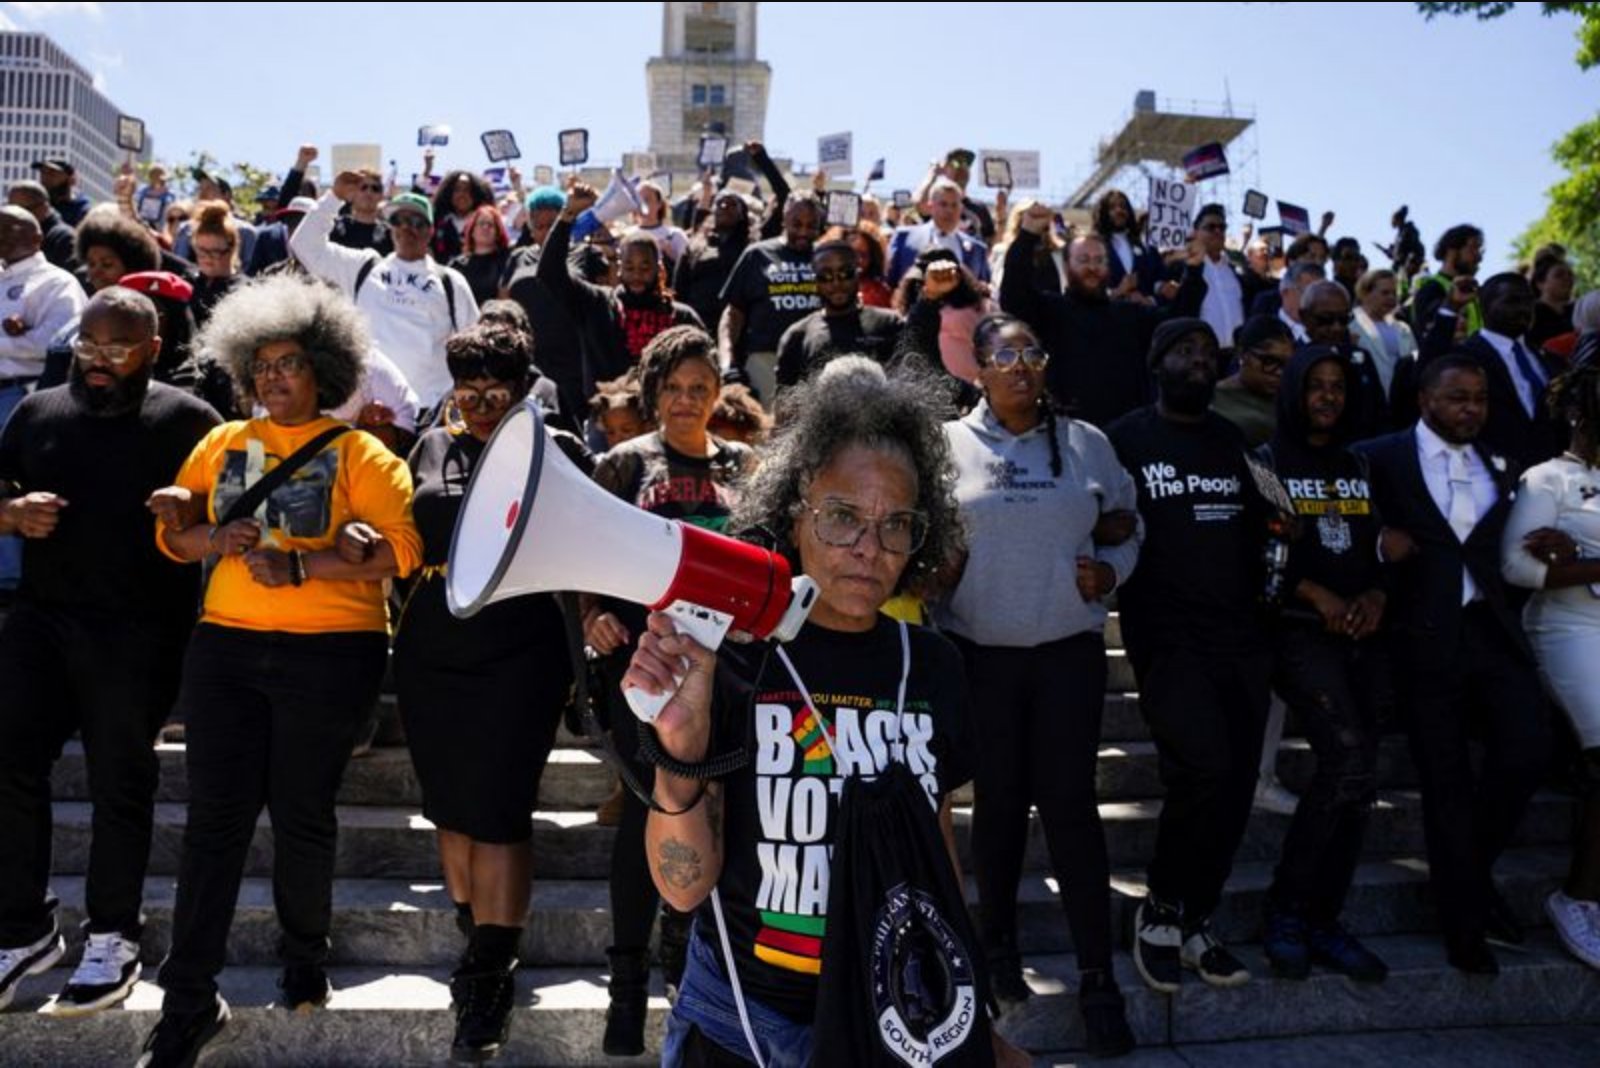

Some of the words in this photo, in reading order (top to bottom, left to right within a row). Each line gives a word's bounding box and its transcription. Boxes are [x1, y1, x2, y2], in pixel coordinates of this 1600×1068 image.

[1156, 181, 1186, 203] NO
[1153, 202, 1190, 227] JIM
[381, 270, 435, 292] NIKE
[1142, 462, 1176, 480] We
[1145, 480, 1185, 499] The
[1284, 478, 1328, 499] REE
[883, 1018, 932, 1064] SOUTH
[933, 995, 973, 1049] REGION
